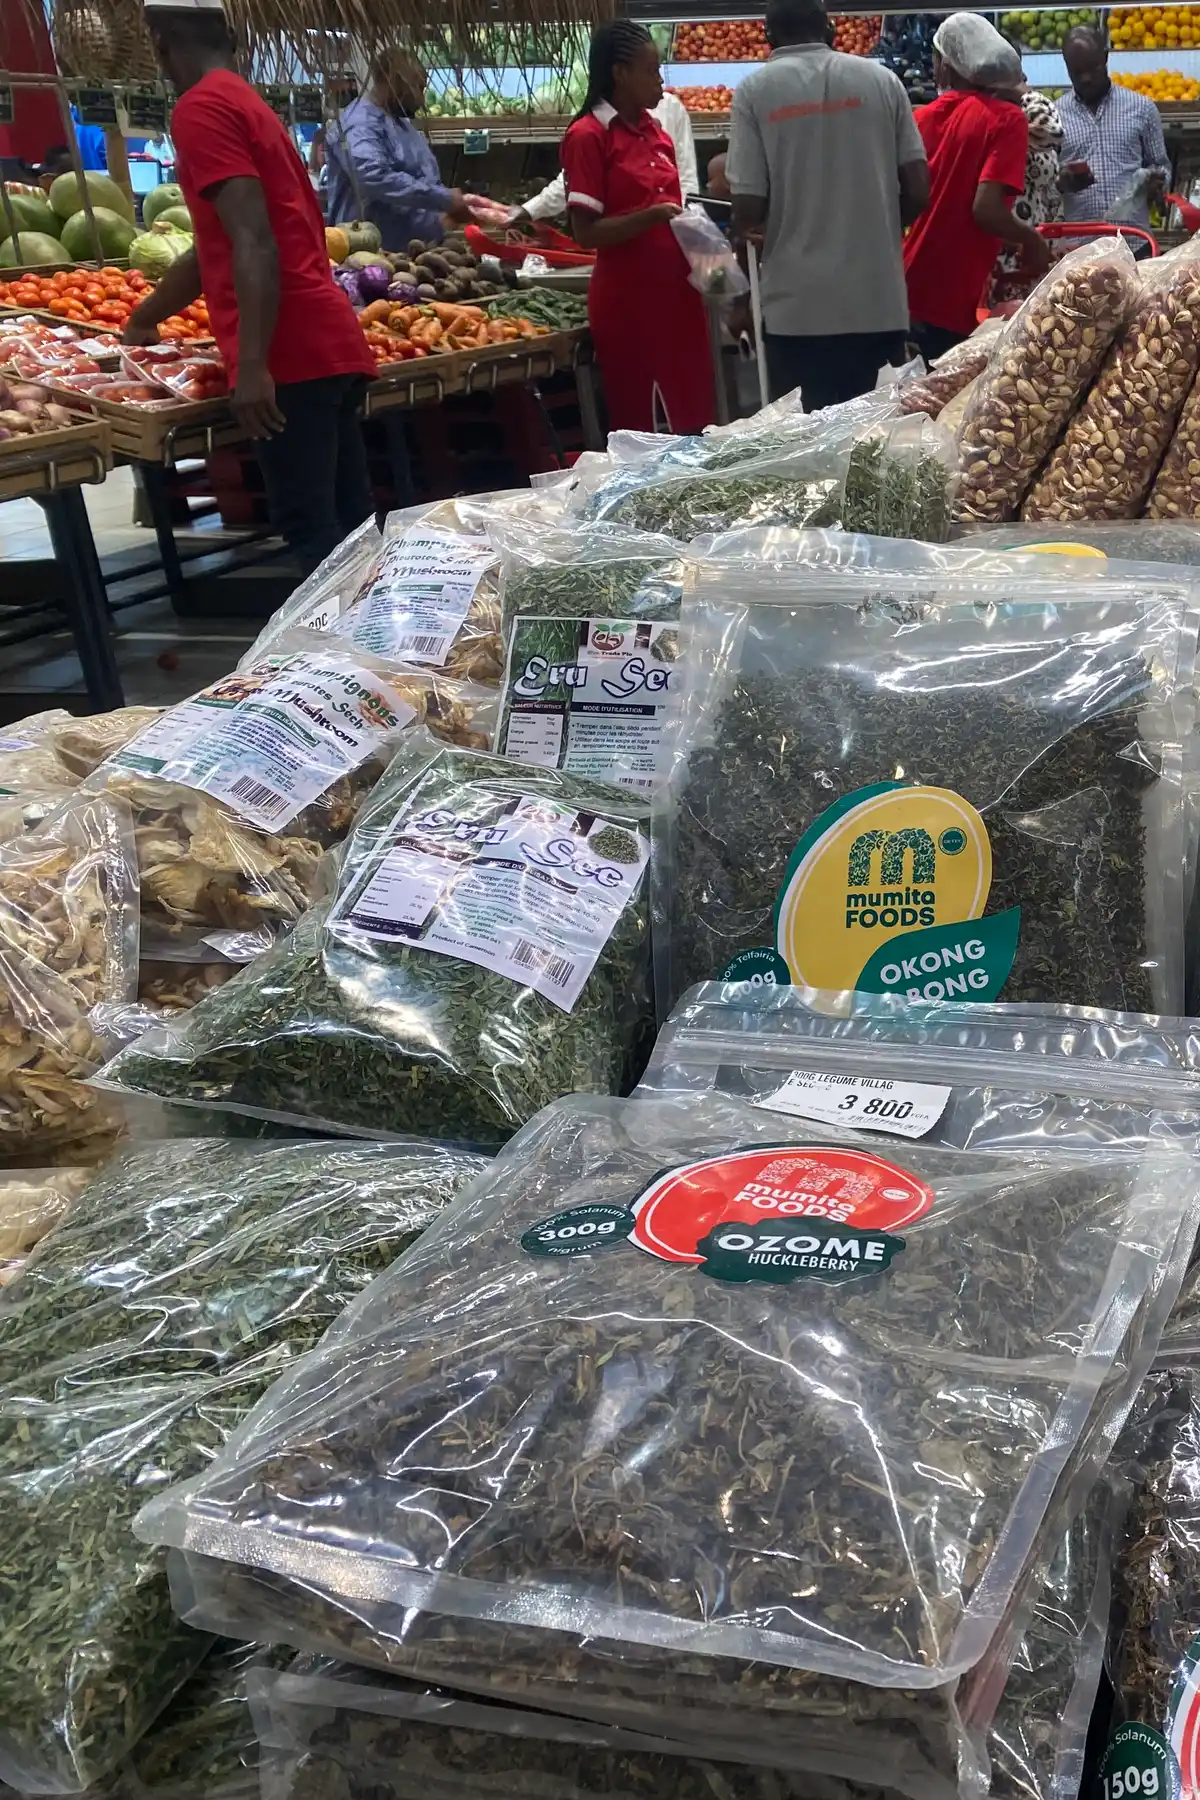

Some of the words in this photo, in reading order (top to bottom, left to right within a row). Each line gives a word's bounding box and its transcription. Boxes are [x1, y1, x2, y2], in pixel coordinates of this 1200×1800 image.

[513, 655, 589, 697] Eru
[601, 657, 672, 699] Se
[582, 705, 601, 713] MODE
[602, 706, 644, 714] D'UTILISATION
[519, 838, 625, 888] Sec
[845, 886, 936, 907] mumita
[845, 907, 935, 929] FOODS
[432, 933, 460, 944] Product
[469, 943, 496, 957] Cameroon
[736, 951, 776, 966] Telfairia
[880, 939, 986, 985] OKONG
[818, 1074, 859, 1086] LEGUME
[861, 1078, 894, 1090] VILLAG
[838, 1094, 859, 1111] 3
[863, 1097, 914, 1119] 800
[732, 1193, 847, 1223] FOODS
[743, 1182, 857, 1215] mumita
[569, 1207, 627, 1222] Solanum
[537, 1220, 616, 1242] 300g
[547, 1239, 603, 1256] nigrum
[718, 1234, 886, 1262] OZOME
[747, 1252, 860, 1272] HUCKLEBERRY
[1115, 1729, 1168, 1760] Solanum
[1103, 1765, 1159, 1800] 150g
